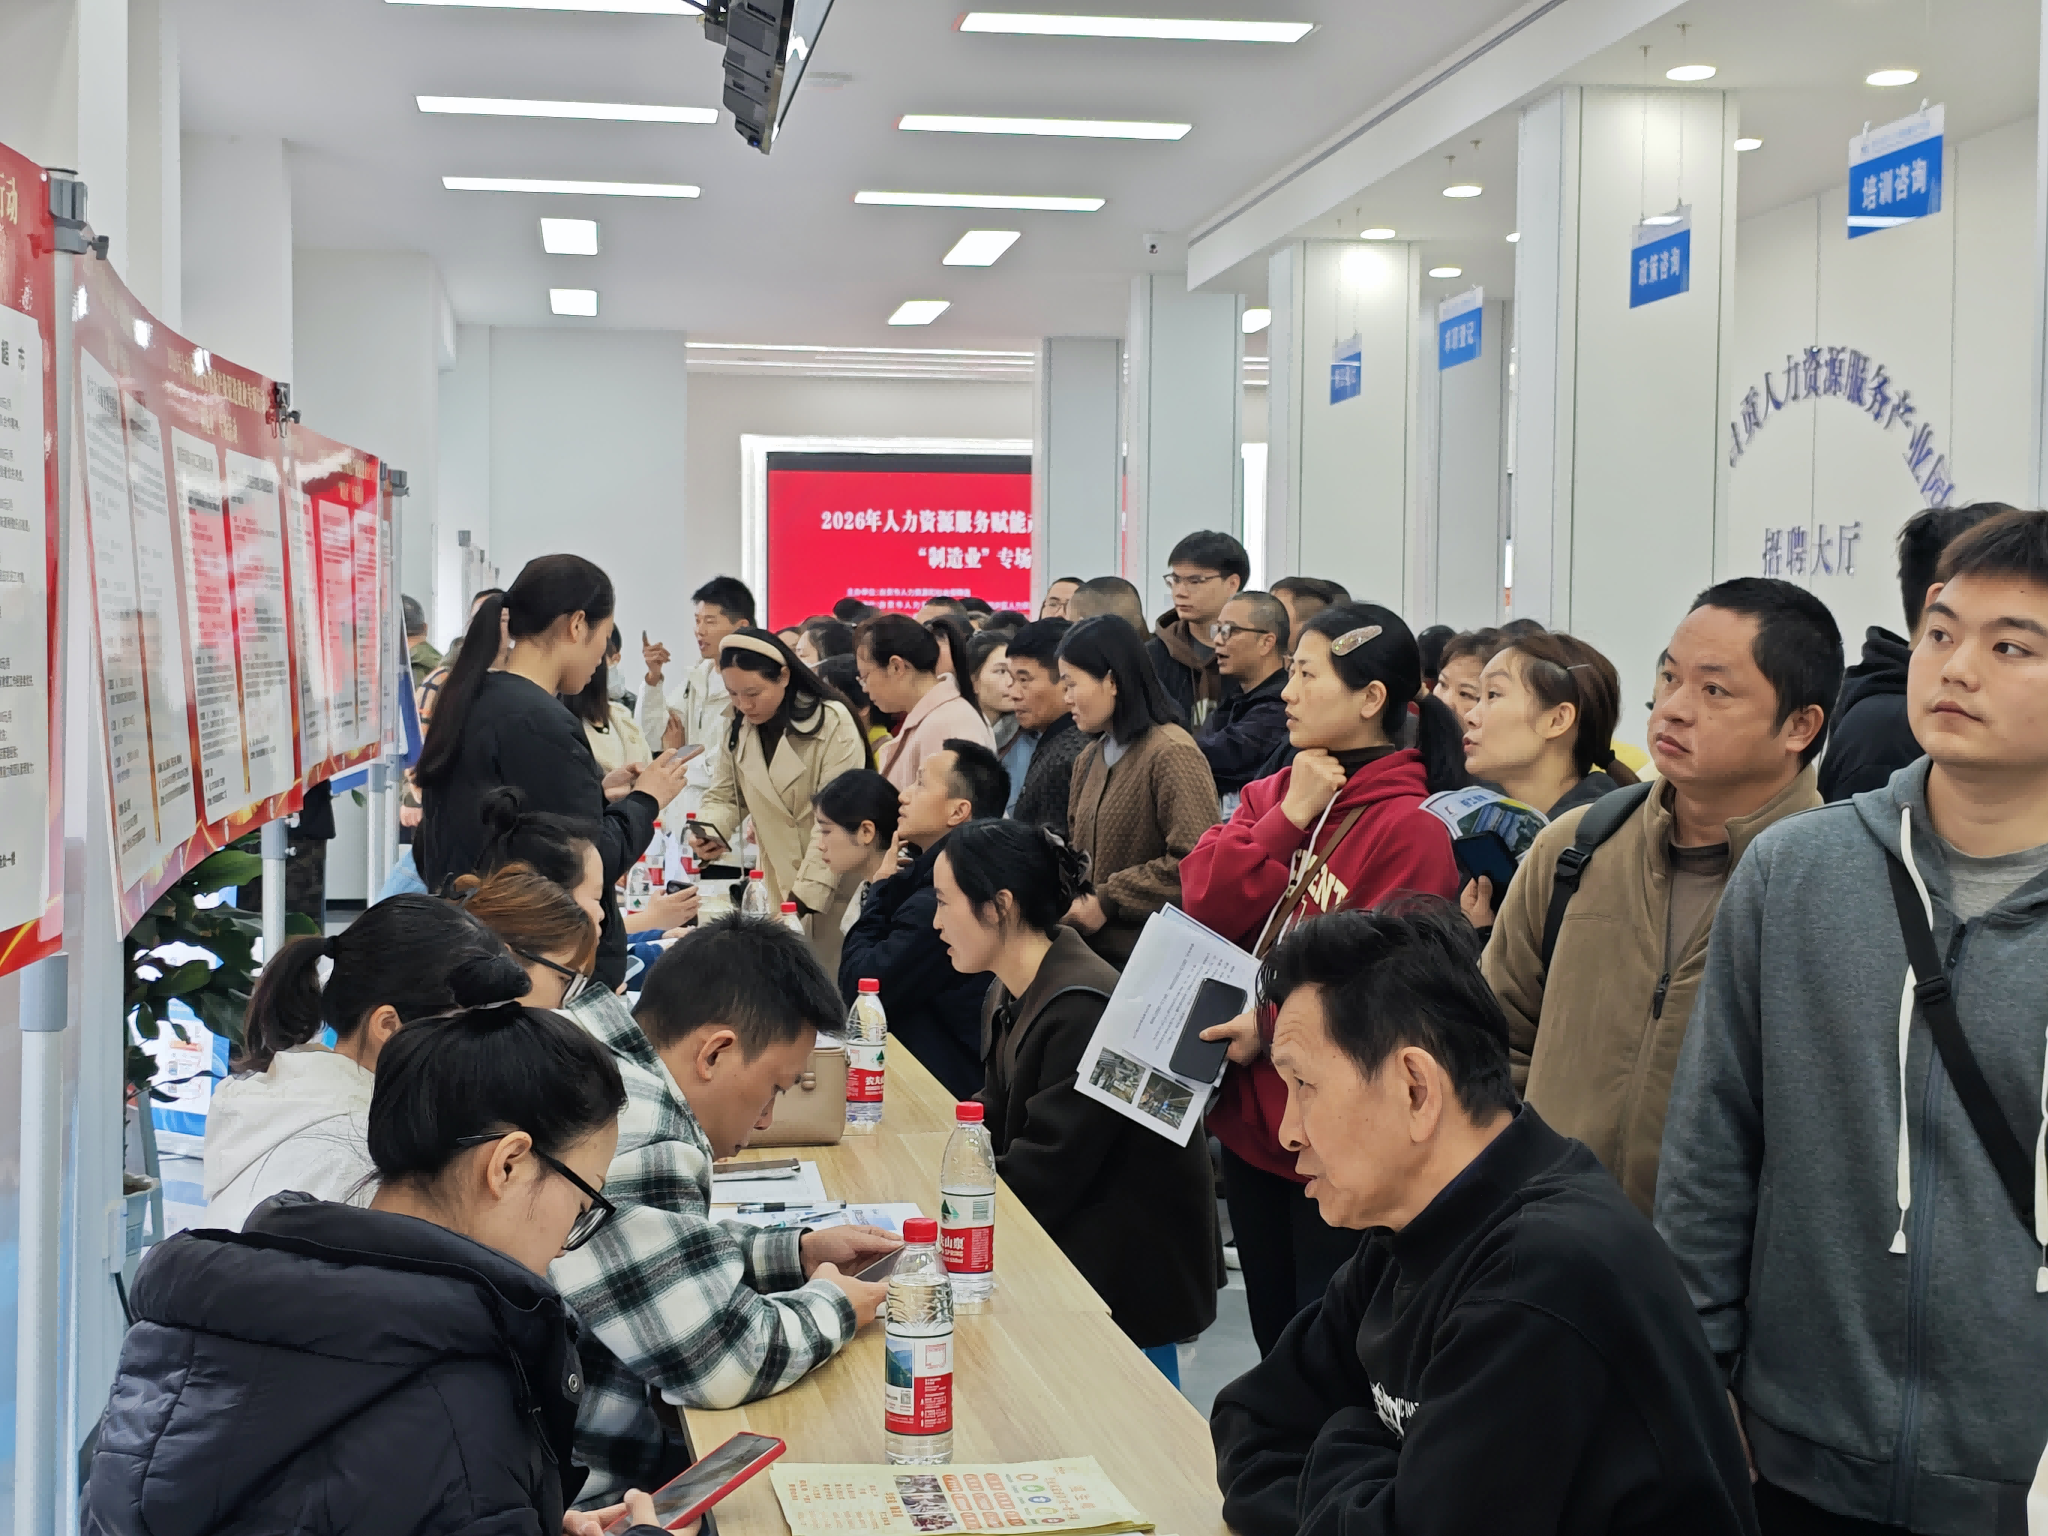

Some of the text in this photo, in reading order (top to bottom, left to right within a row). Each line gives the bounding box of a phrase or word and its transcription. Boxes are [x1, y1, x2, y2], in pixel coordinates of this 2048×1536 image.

[1862, 157, 1928, 211] 培训咨询
[1638, 246, 1681, 287] 政策咨询
[1763, 520, 1863, 578] 招聘大厅
